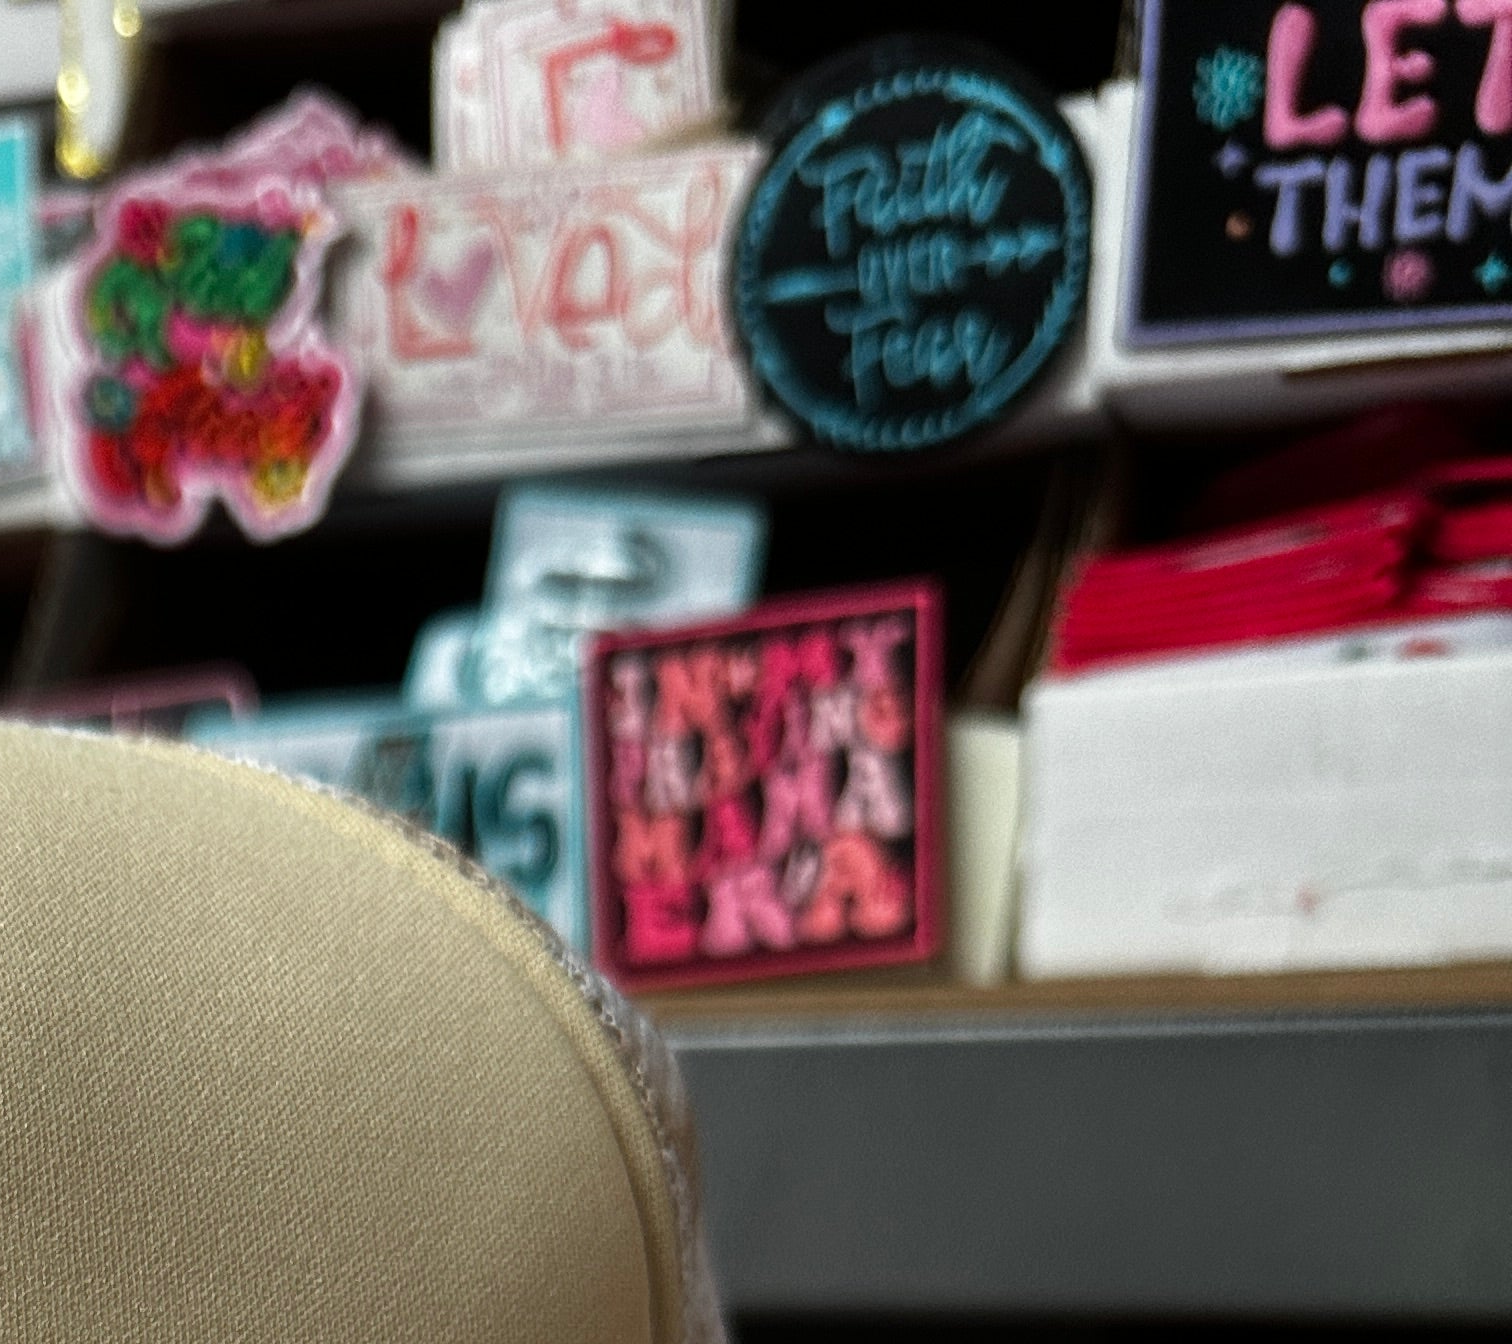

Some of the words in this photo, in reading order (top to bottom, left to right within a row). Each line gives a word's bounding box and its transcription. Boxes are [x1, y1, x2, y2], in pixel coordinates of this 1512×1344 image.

[1262, 0, 1512, 149] LET
[798, 108, 1028, 258] Faith
[1252, 140, 1512, 257] THEM
